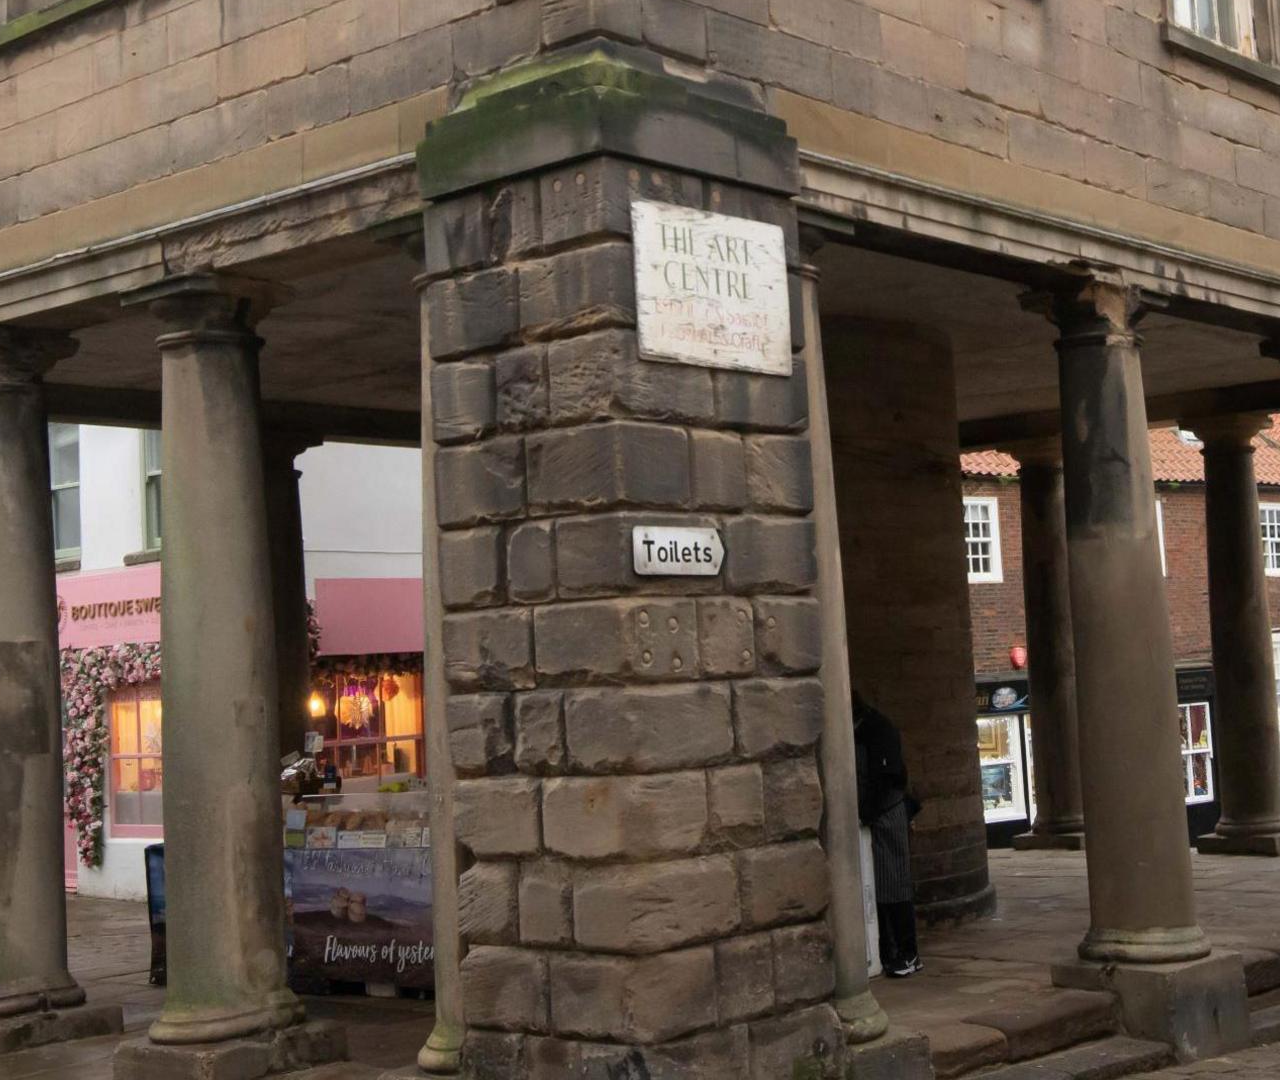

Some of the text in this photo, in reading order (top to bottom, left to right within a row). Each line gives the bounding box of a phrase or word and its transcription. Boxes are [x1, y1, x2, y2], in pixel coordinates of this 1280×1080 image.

[655, 222, 752, 266] THE ART
[663, 260, 753, 301] CENTRE
[642, 539, 713, 563] Toilets
[71, 600, 134, 621] BOUTIQUE
[324, 934, 377, 964] Flavours
[381, 938, 396, 964] of
